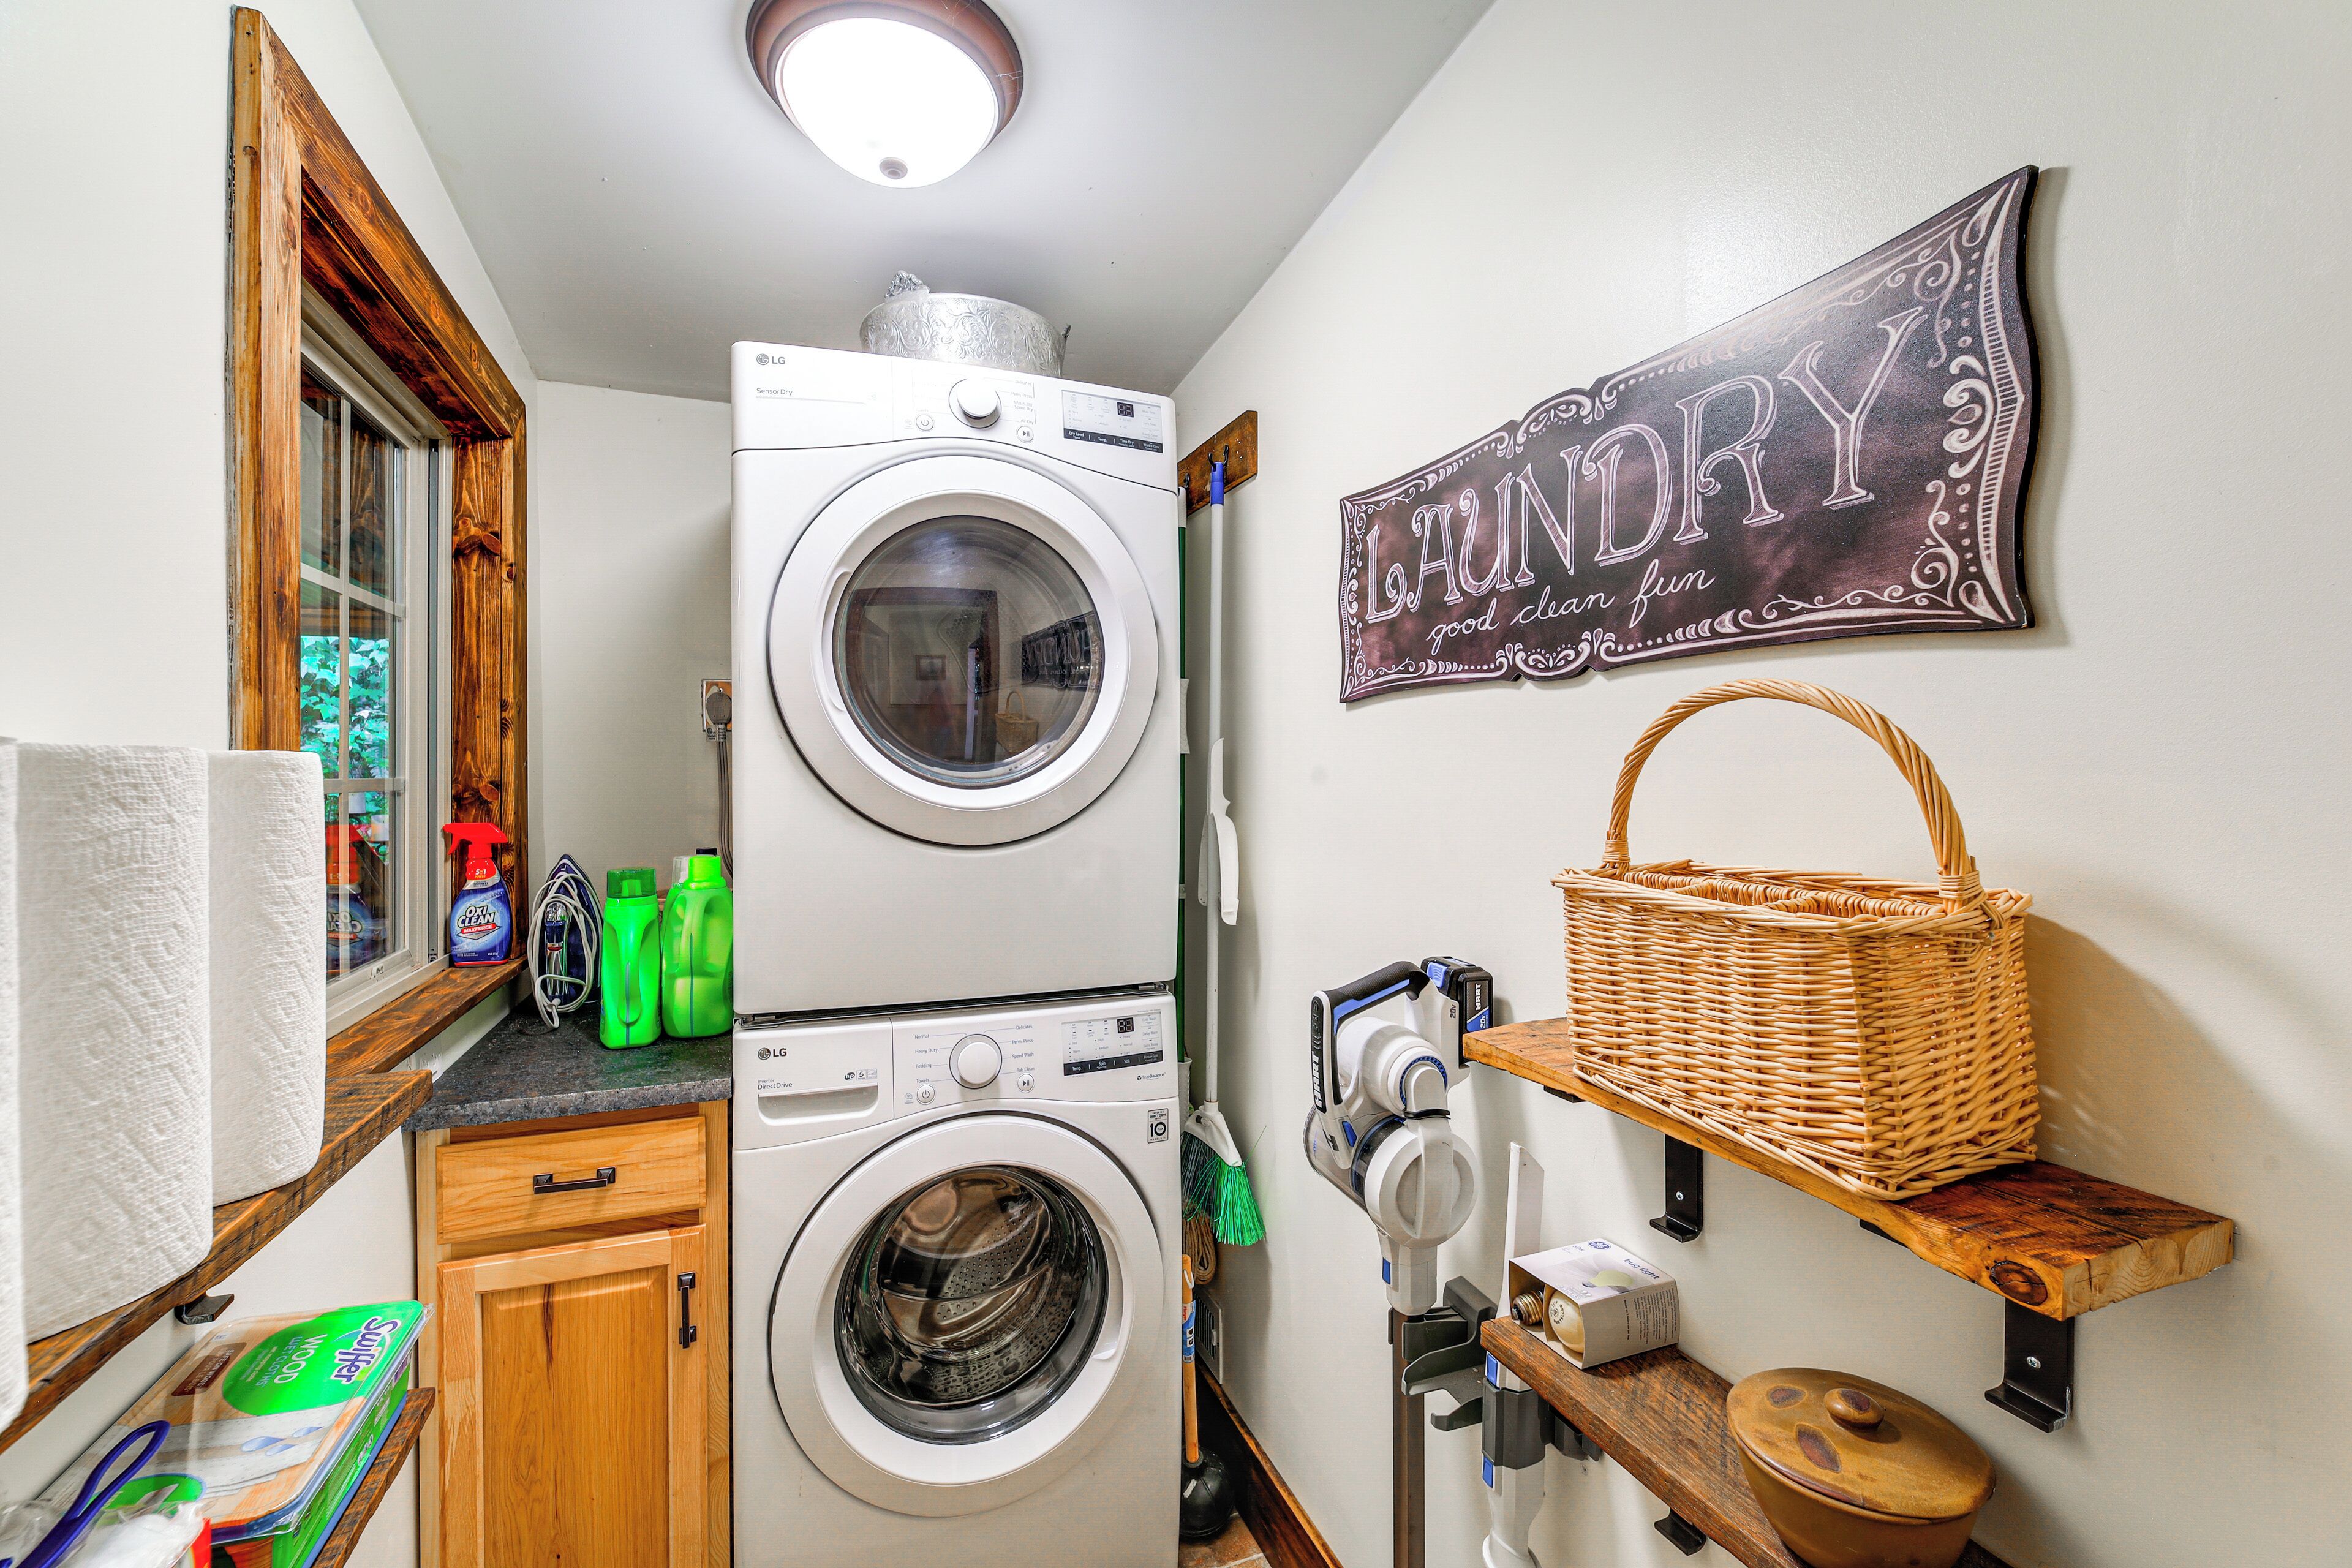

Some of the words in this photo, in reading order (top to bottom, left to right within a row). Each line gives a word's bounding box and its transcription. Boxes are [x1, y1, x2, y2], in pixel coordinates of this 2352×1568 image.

[772, 356, 785, 365] LG
[1366, 307, 1927, 623] LAUNDRY
[1427, 610, 1498, 658] good
[1510, 588, 1615, 630] clean
[1629, 559, 1715, 630] fun
[458, 912, 496, 928] CLEAN
[466, 906, 488, 918] OXI
[464, 924, 492, 933] MAXFORCE
[773, 1048, 787, 1058] LG
[1311, 1050, 1323, 1109] HART
[1150, 1121, 1166, 1137] 10
[1624, 1259, 1640, 1268] bug
[1640, 1267, 1660, 1280] light
[282, 1335, 304, 1354] WET
[334, 1317, 401, 1383] Swiffer
[220, 1349, 235, 1362] SAFE
[274, 1334, 328, 1384] WOOD
[212, 1362, 223, 1371] ON
[255, 1355, 287, 1387] CLOTHS
